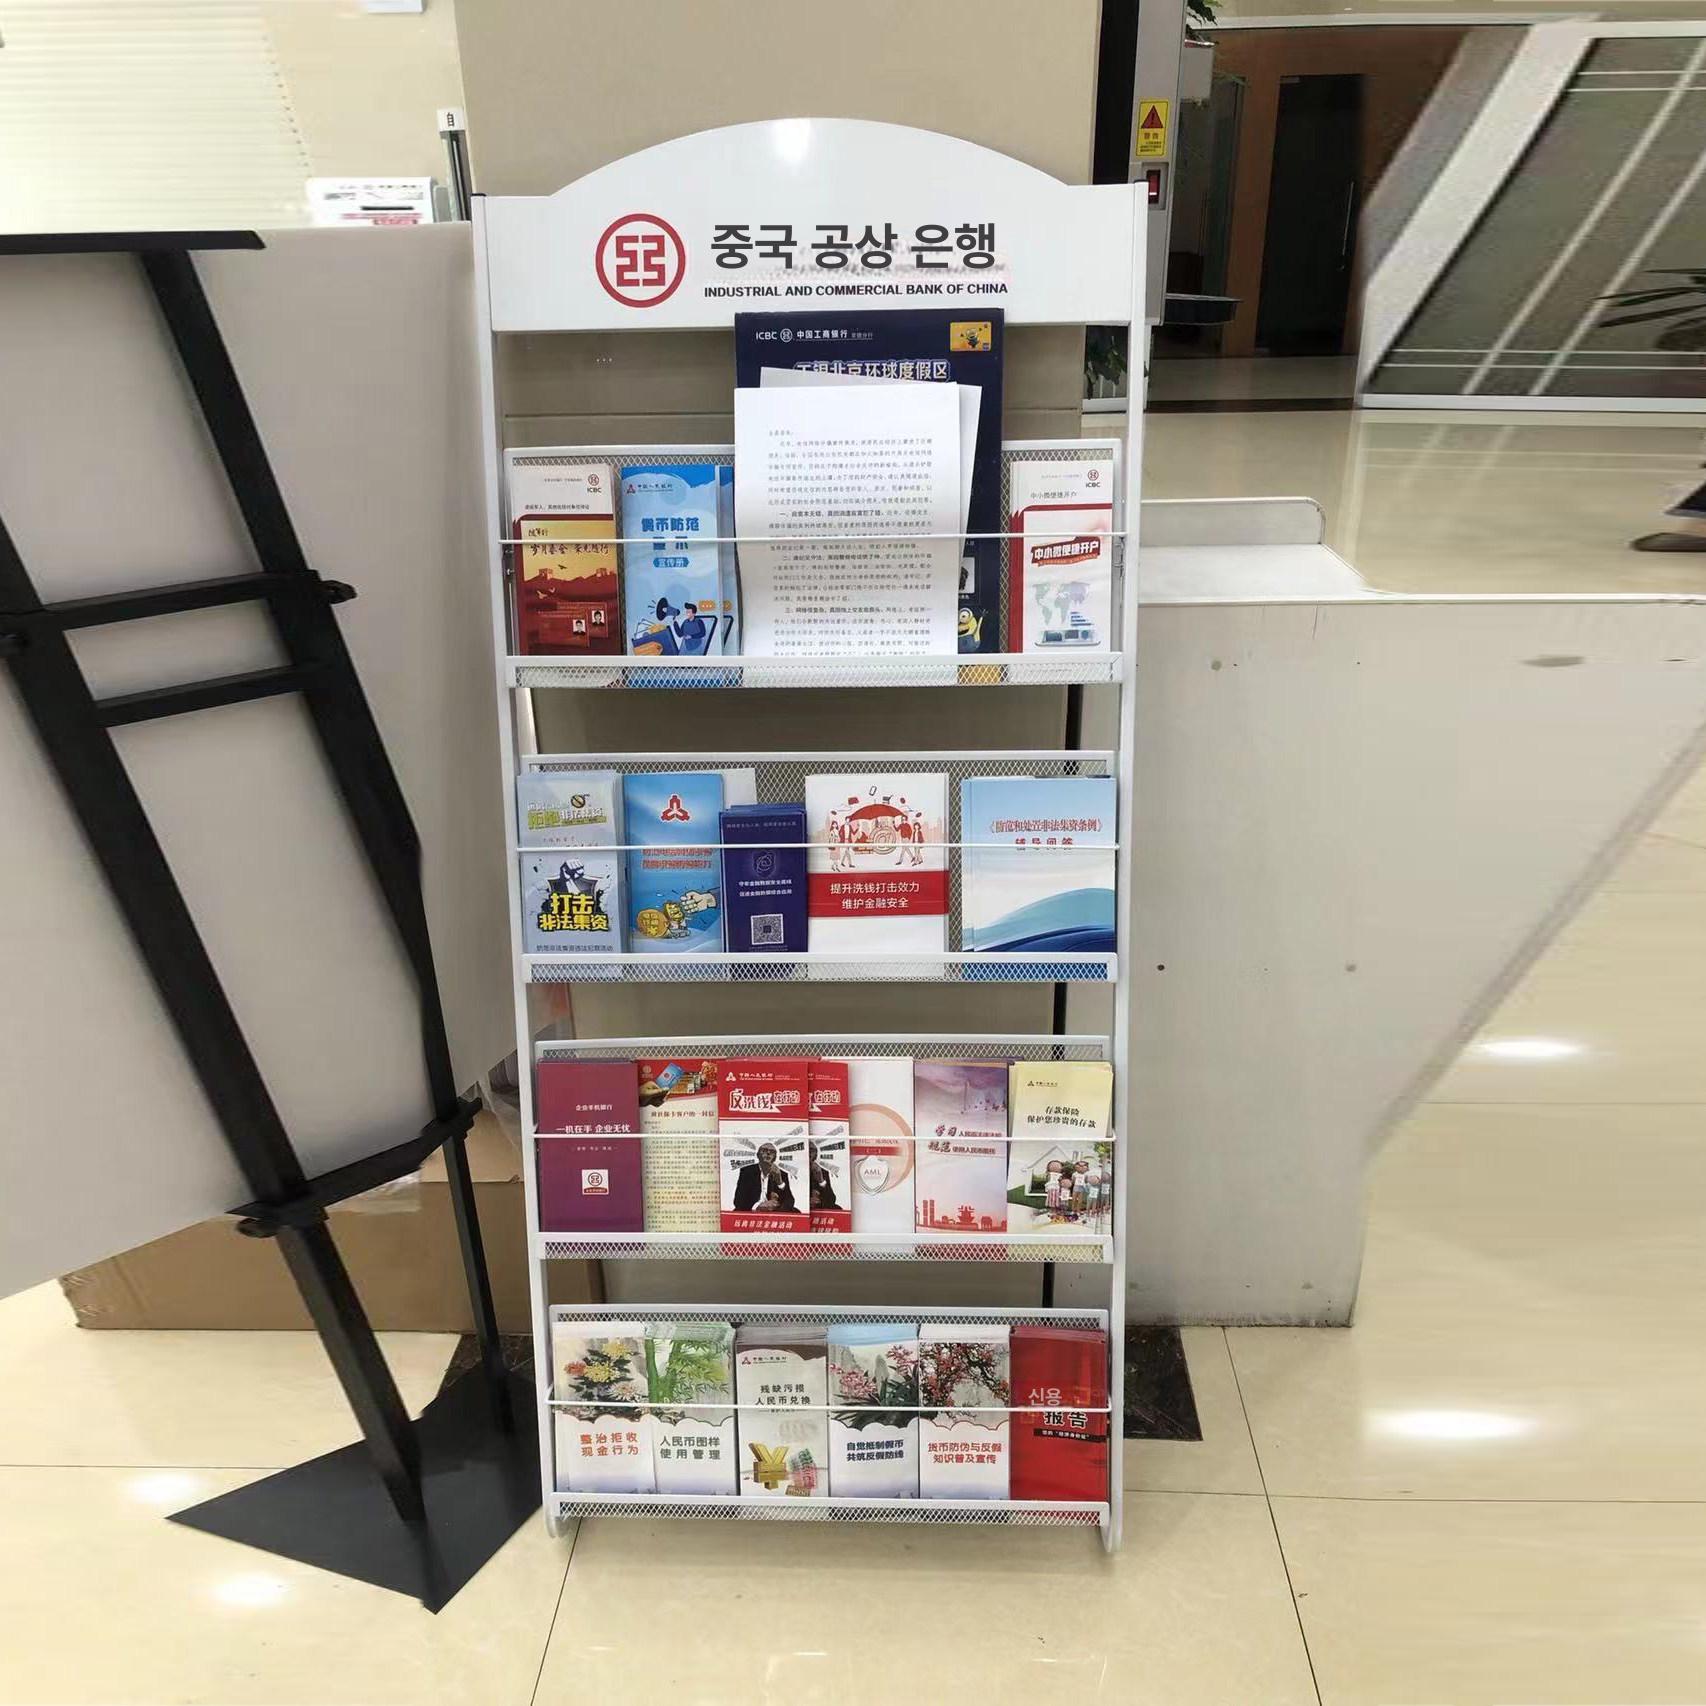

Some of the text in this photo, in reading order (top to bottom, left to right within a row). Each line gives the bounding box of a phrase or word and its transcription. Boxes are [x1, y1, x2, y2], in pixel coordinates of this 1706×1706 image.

[711, 222, 996, 269] 중국 공상 은행
[704, 283, 1008, 298] INDUSTRIAL AND COMMERCIAL BANK OF CHINA
[756, 331, 778, 341] ICBC
[796, 329, 849, 340] 中国工商银行
[830, 881, 920, 895] 提升洗钱打击效力
[550, 892, 595, 915] 打击
[842, 897, 909, 910] 维护金融安全
[538, 913, 609, 931] 非法集资
[1045, 1105, 1080, 1117] 存款保险
[1027, 1115, 1097, 1129] 保护您珍贵的存款
[555, 1123, 631, 1134] 一机在手 企业无忧
[935, 1125, 958, 1137] 学习
[760, 1383, 805, 1393] 残缺污损
[755, 1396, 811, 1406] 人民币兑换
[1028, 1387, 1063, 1407] 신용
[1044, 1411, 1088, 1429] 报告
[580, 1431, 638, 1445] 整治拒收
[660, 1435, 721, 1447] 人民币图样
[581, 1445, 639, 1457] 现金行为
[846, 1439, 904, 1451] 自觉抵制假币
[928, 1442, 1001, 1453] 货币防伪与反假
[660, 1448, 721, 1460] 使用管理
[846, 1450, 904, 1462] 共筑反假防线
[933, 1453, 997, 1464] 知识普及宣传
